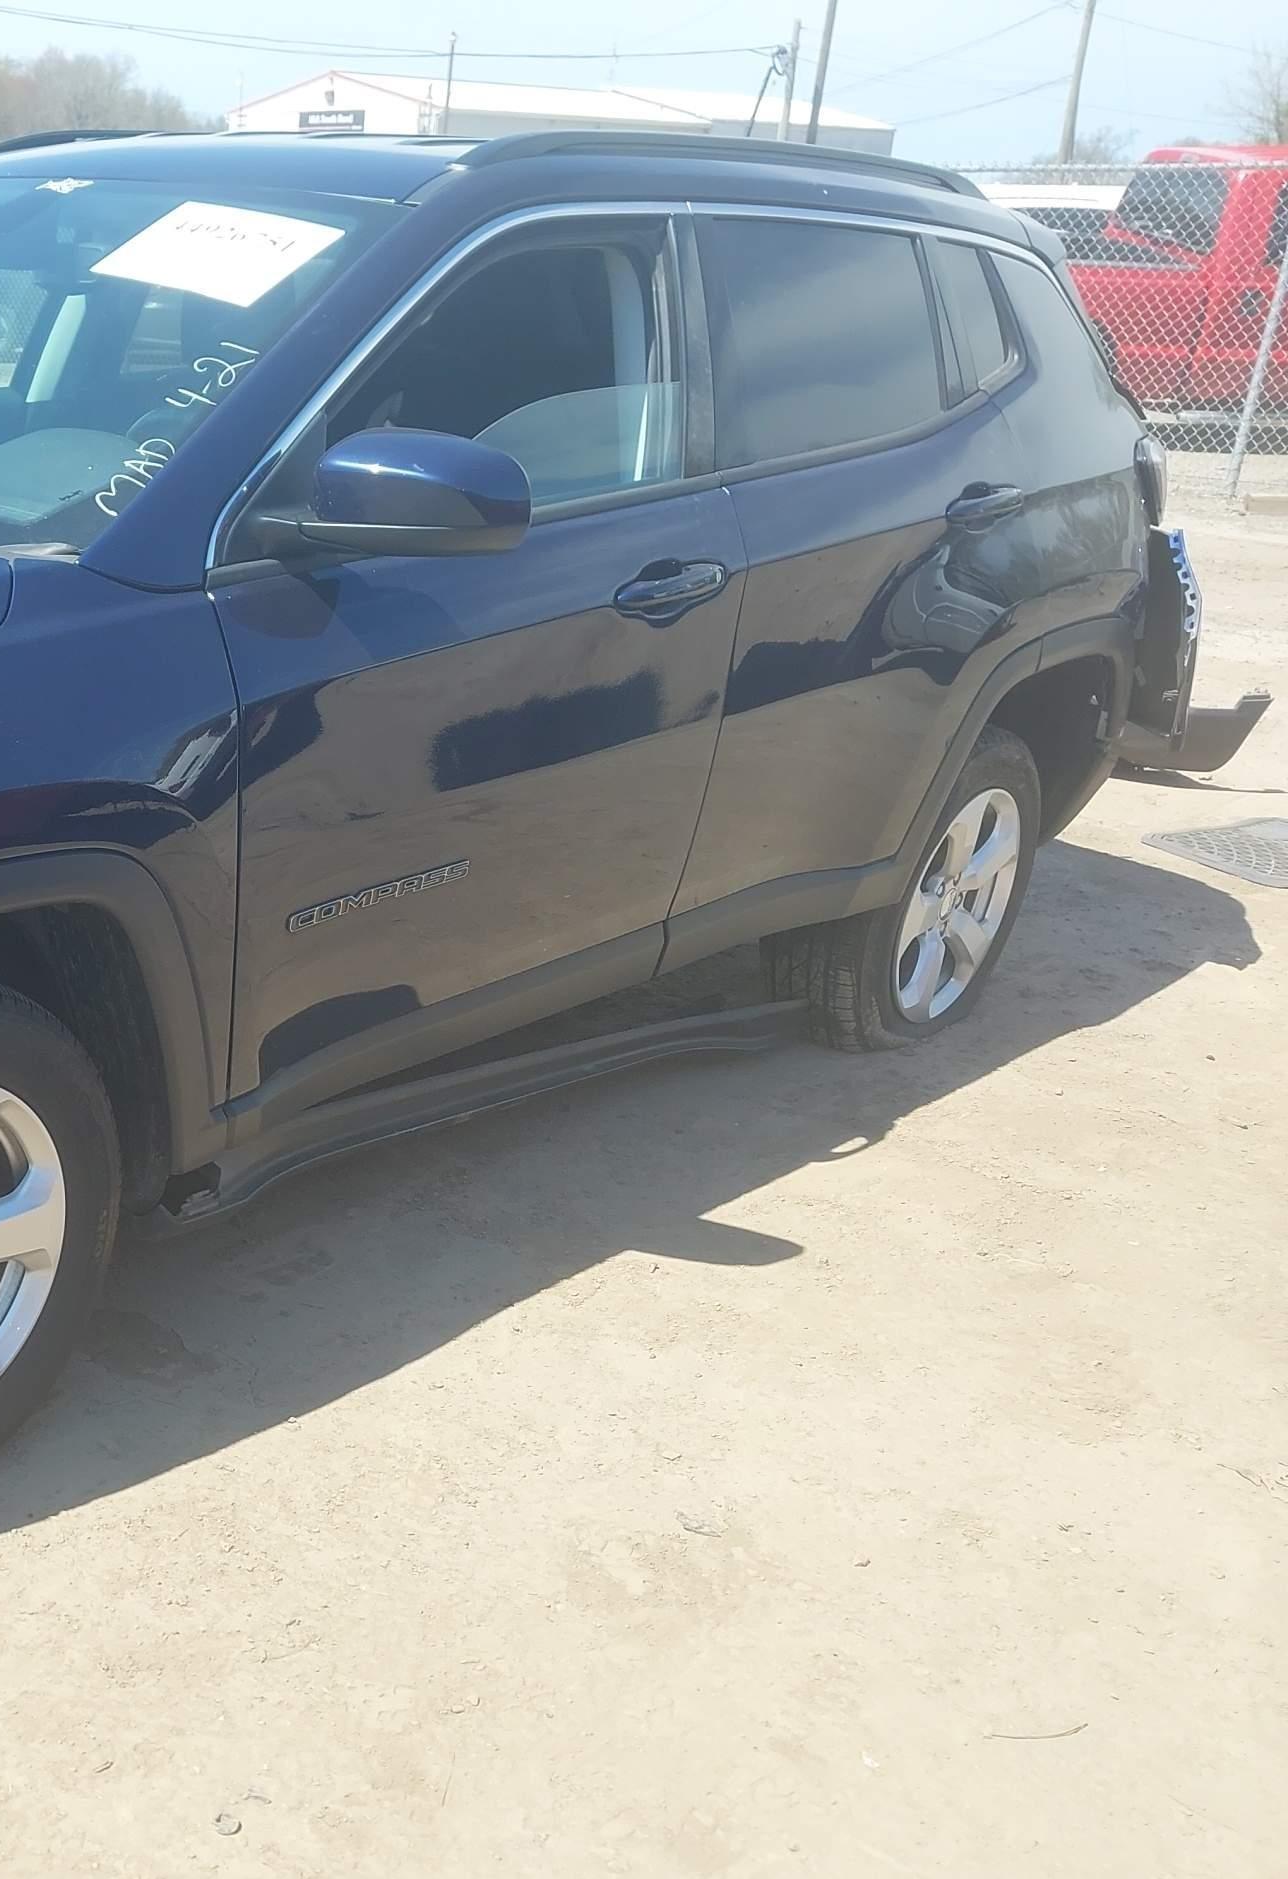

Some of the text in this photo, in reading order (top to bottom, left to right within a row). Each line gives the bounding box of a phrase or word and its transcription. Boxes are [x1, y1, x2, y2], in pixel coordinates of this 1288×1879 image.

[95, 340, 261, 517] MAD 4-21
[288, 859, 471, 934] COMPASS
